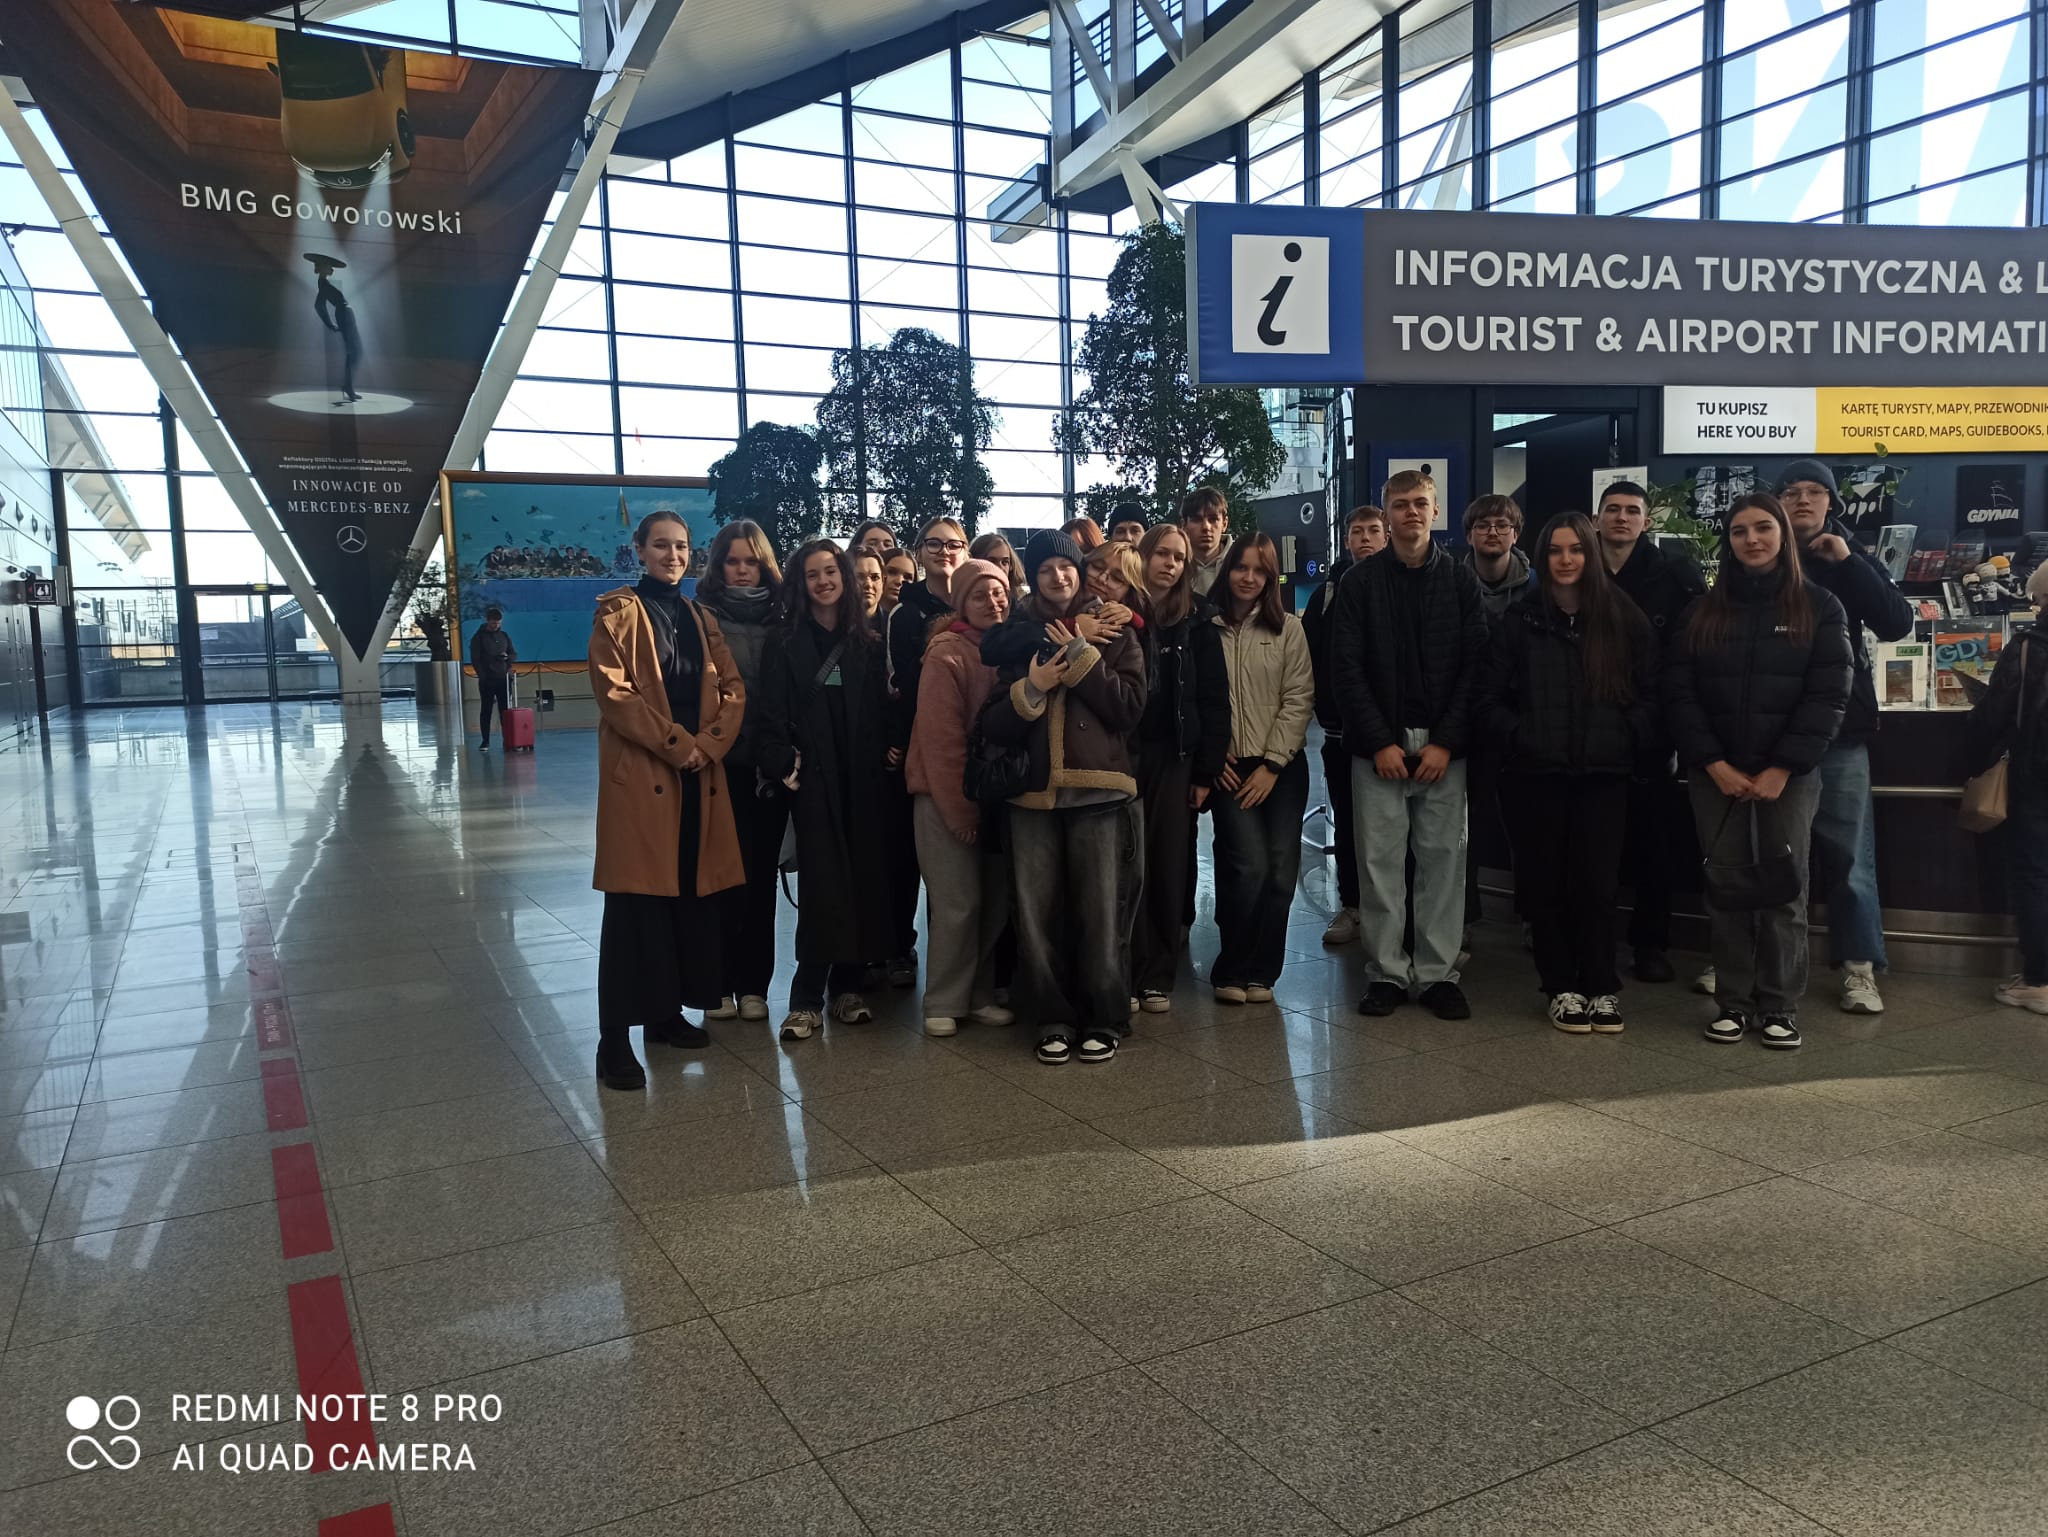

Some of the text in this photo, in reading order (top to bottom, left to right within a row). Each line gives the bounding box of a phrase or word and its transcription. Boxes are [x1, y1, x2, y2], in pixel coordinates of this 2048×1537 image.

[181, 183, 462, 234] BMG Goworowski
[1395, 249, 1682, 290] INFORMACJA
[1696, 256, 1987, 294] TURYSTYCZNA
[1999, 261, 2023, 294] &
[1392, 315, 2047, 354] TOURIST & AIRPORT INFORMATI
[1697, 402, 1768, 416] TU KUPISZ
[1841, 403, 1879, 416] KARTĘ
[1882, 403, 1935, 416] TURYSTY,
[1937, 403, 1972, 415] MAPY,
[1697, 425, 1797, 438] HERE YOU BUY
[1841, 425, 2044, 438] TOURIST CARD, MAPS, GUIDEBOOKS,
[293, 479, 402, 493] INNOWACJE OD
[287, 500, 410, 514] MERCEDES-BENZ
[1967, 508, 2019, 523] GDYNIA
